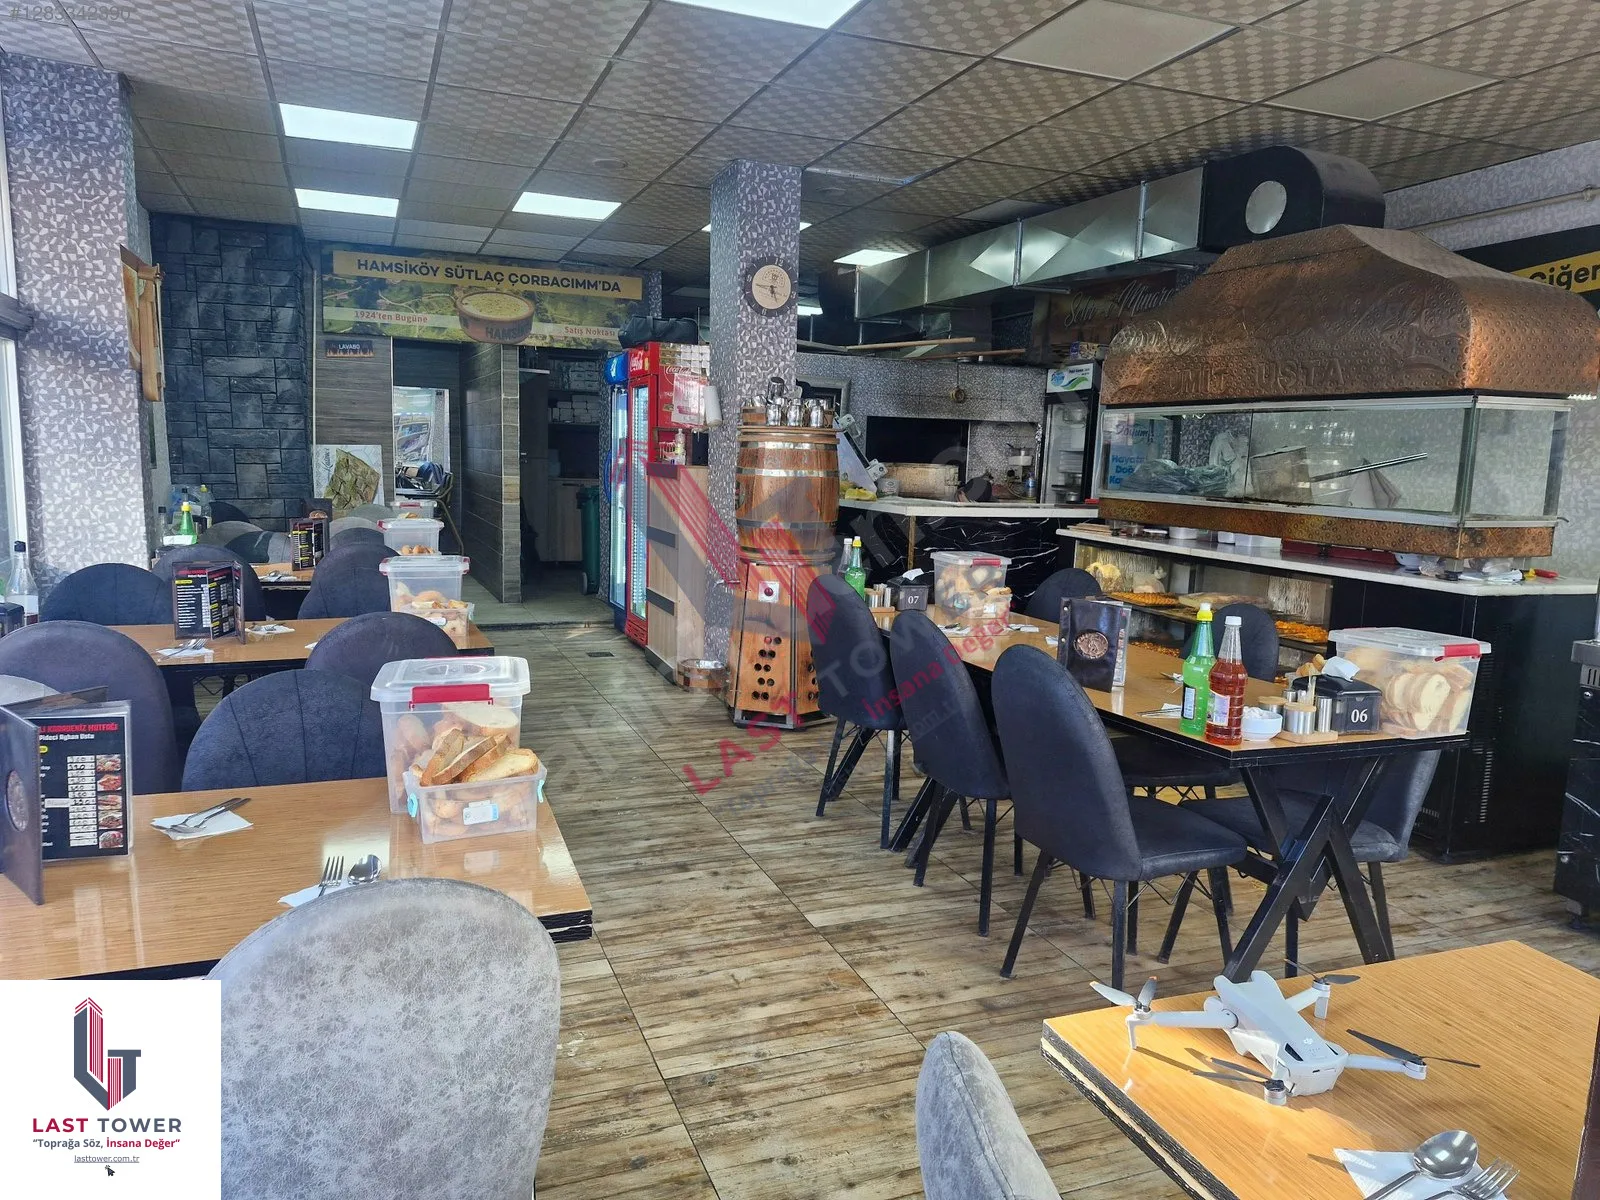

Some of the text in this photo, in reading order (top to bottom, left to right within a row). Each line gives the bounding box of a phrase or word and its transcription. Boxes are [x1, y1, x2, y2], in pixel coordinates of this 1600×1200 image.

[356, 259, 621, 293] HAMSİKÖY SÜTLAÇ ÇORBACIMM'DA
[354, 310, 428, 323] 1924'ten Bugüne
[564, 326, 615, 337] Satış Noktası
[907, 595, 919, 605] 07
[1350, 708, 1368, 723] 06
